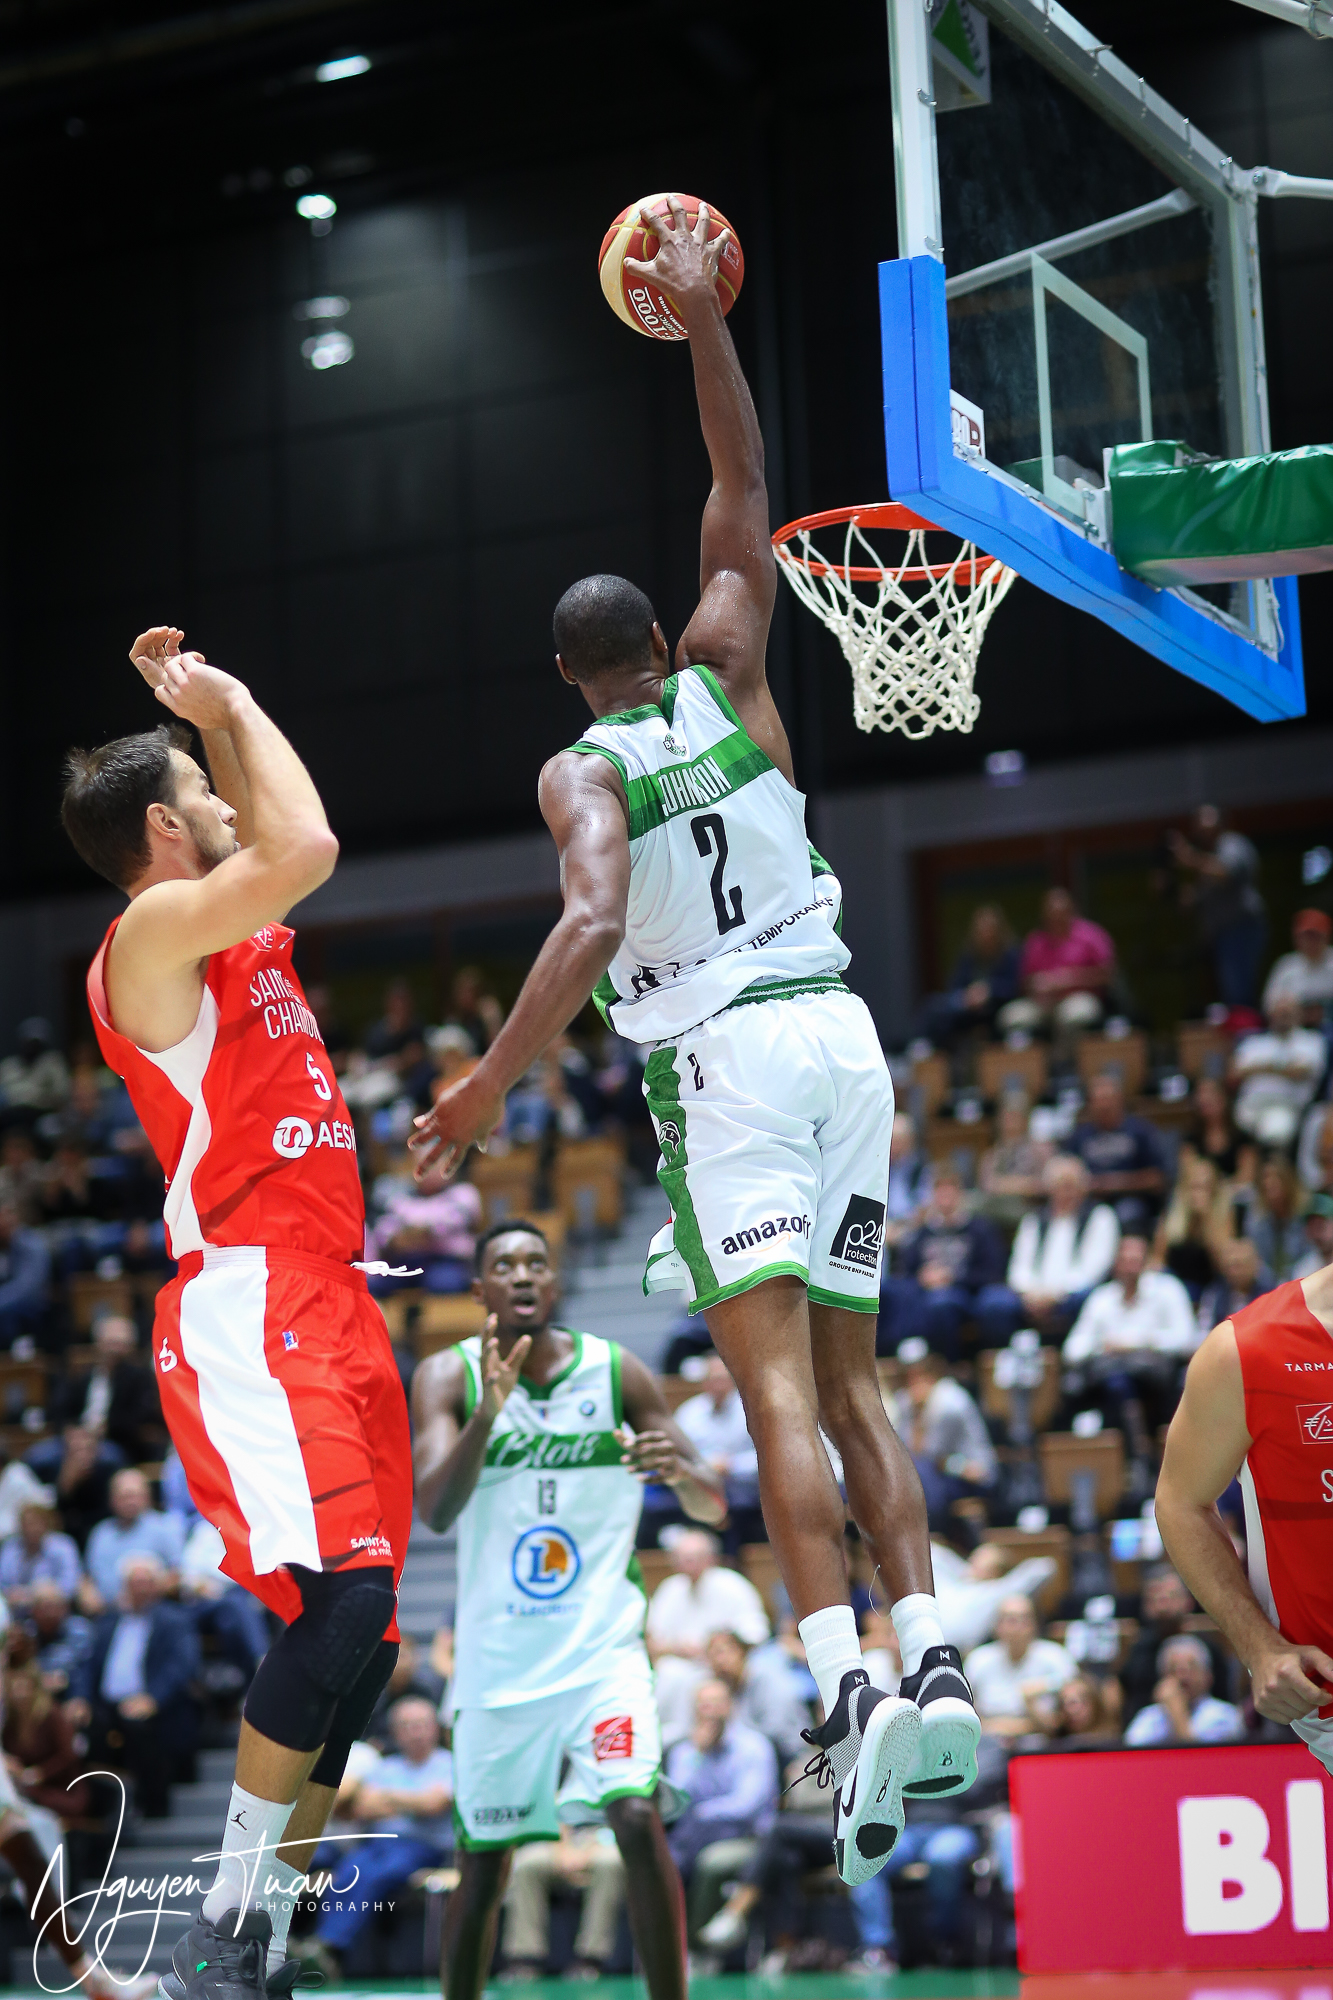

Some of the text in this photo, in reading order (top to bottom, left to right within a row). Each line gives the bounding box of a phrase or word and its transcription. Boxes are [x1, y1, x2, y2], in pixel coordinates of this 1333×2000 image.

[690, 812, 746, 936] 2
[249, 968, 295, 1007] SAIN
[306, 1051, 333, 1101] 5
[687, 1053, 704, 1091] 2
[828, 1260, 852, 1272] GROUPE
[538, 1478, 557, 1515] 13
